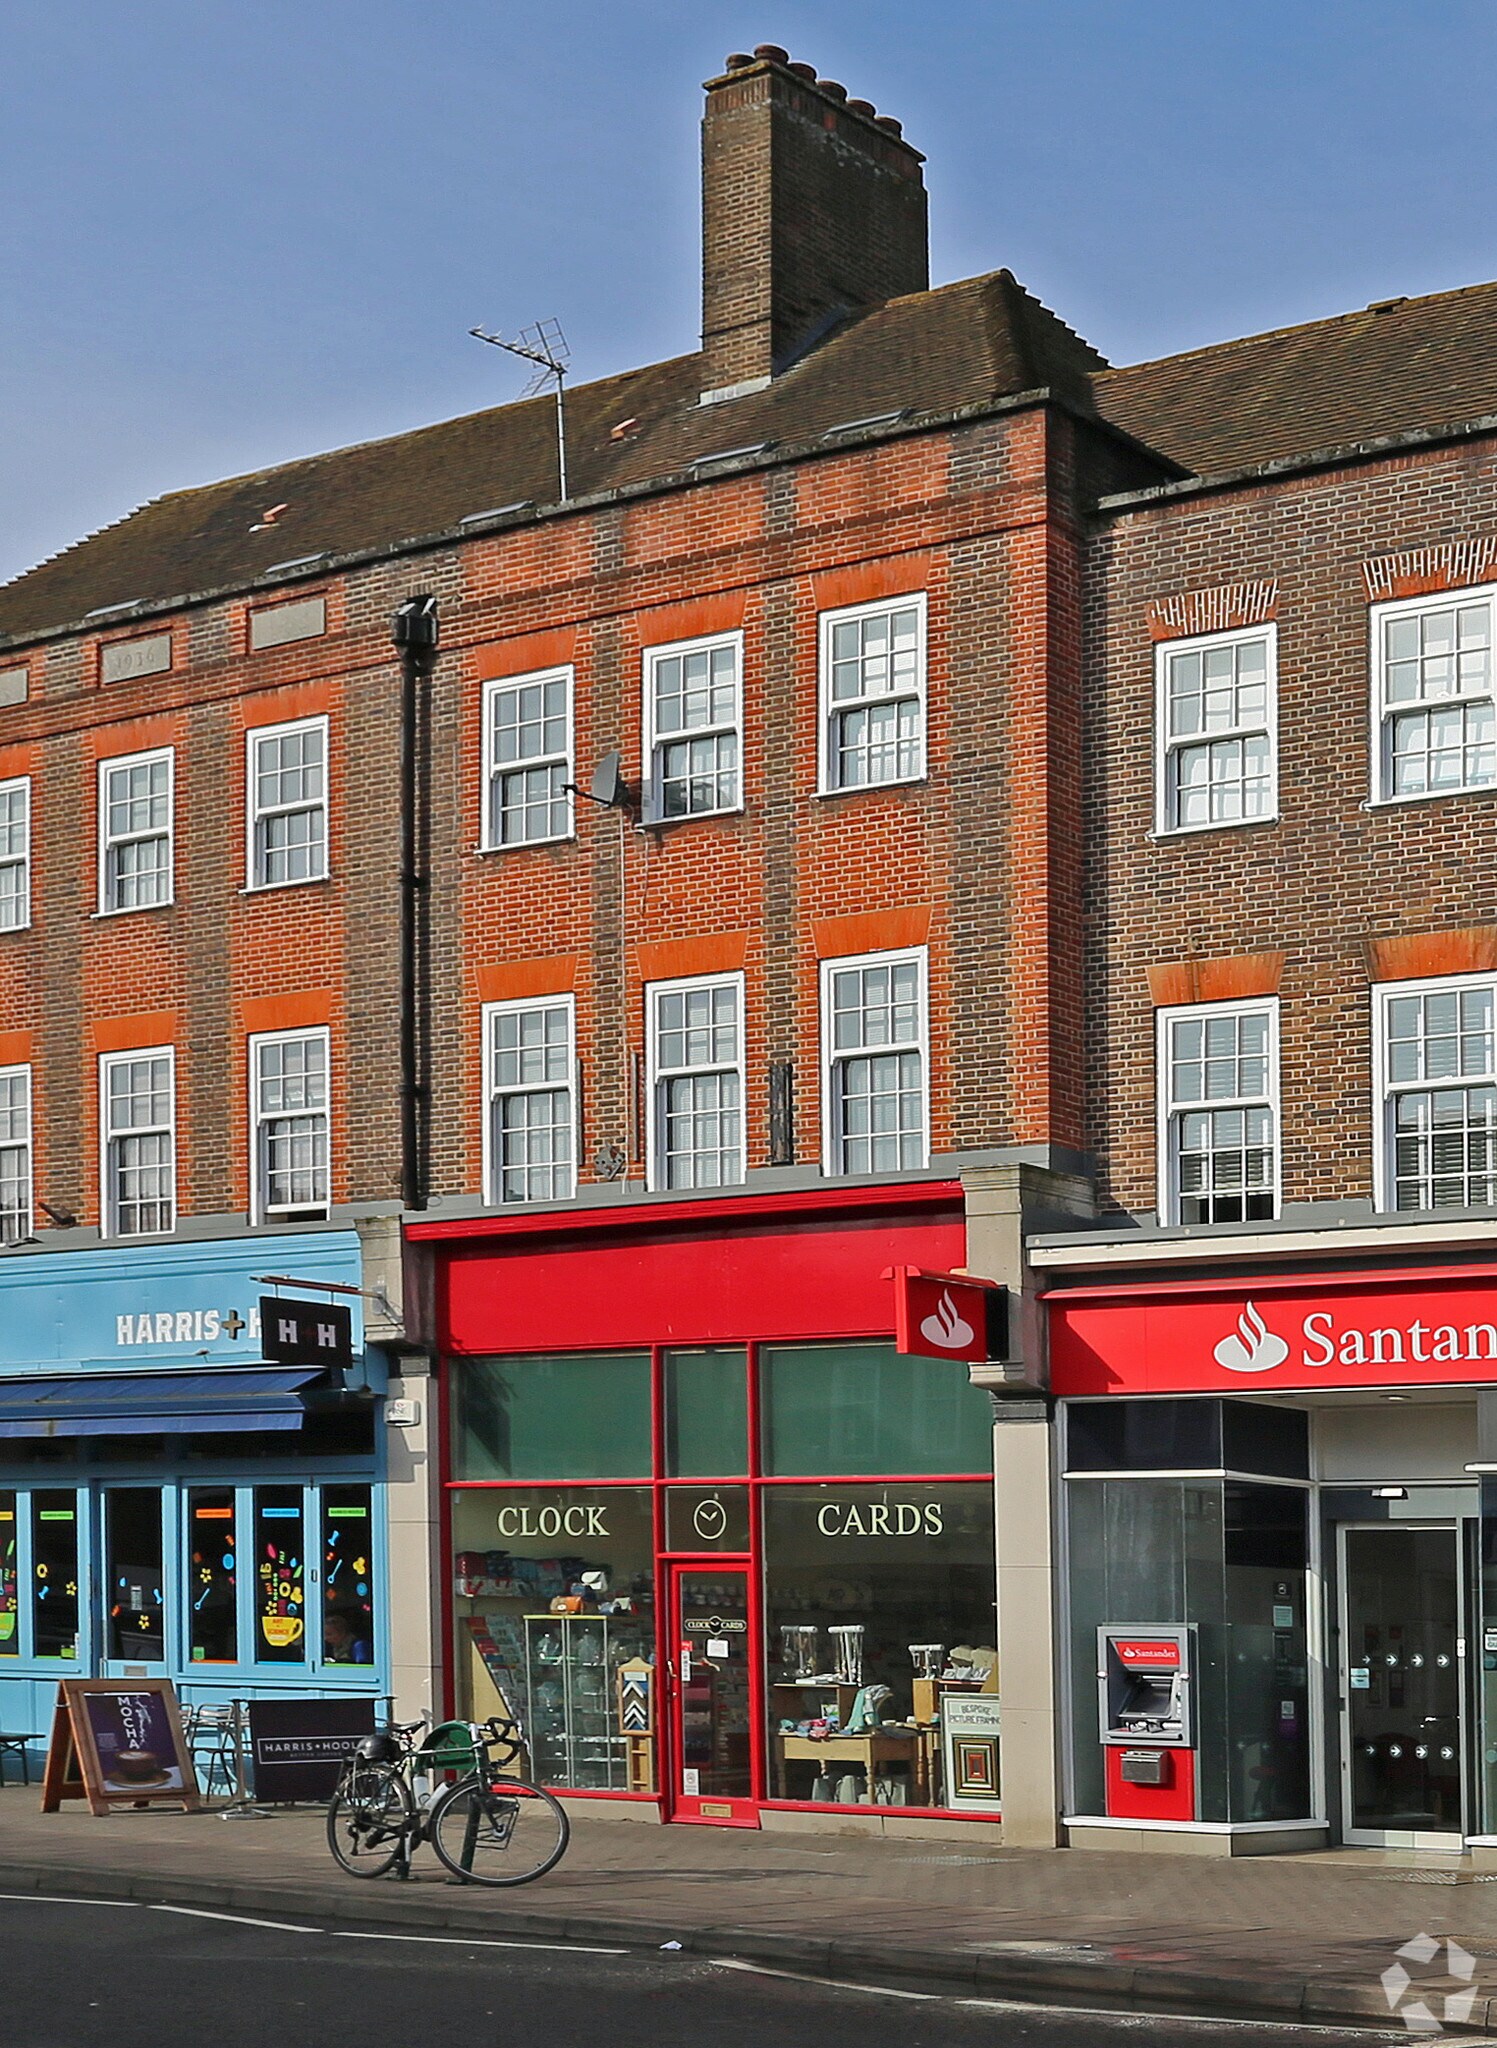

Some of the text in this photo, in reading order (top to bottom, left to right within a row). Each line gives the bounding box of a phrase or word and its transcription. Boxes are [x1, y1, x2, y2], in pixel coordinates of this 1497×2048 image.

[116, 646, 154, 671] 1936
[116, 1310, 220, 1345] HARRIS
[1301, 1311, 1497, 1367] Santan
[497, 1506, 610, 1537] CLOCK
[817, 1503, 944, 1536] CARDS
[687, 1621, 744, 1629] CLOCK CARDS
[1135, 1649, 1176, 1658] Santander
[950, 1715, 975, 1723] PICTURE
[961, 1704, 992, 1715] BESPOKE
[117, 1696, 140, 1750] MOCHA
[265, 1740, 359, 1752] HARRIS HOOL
